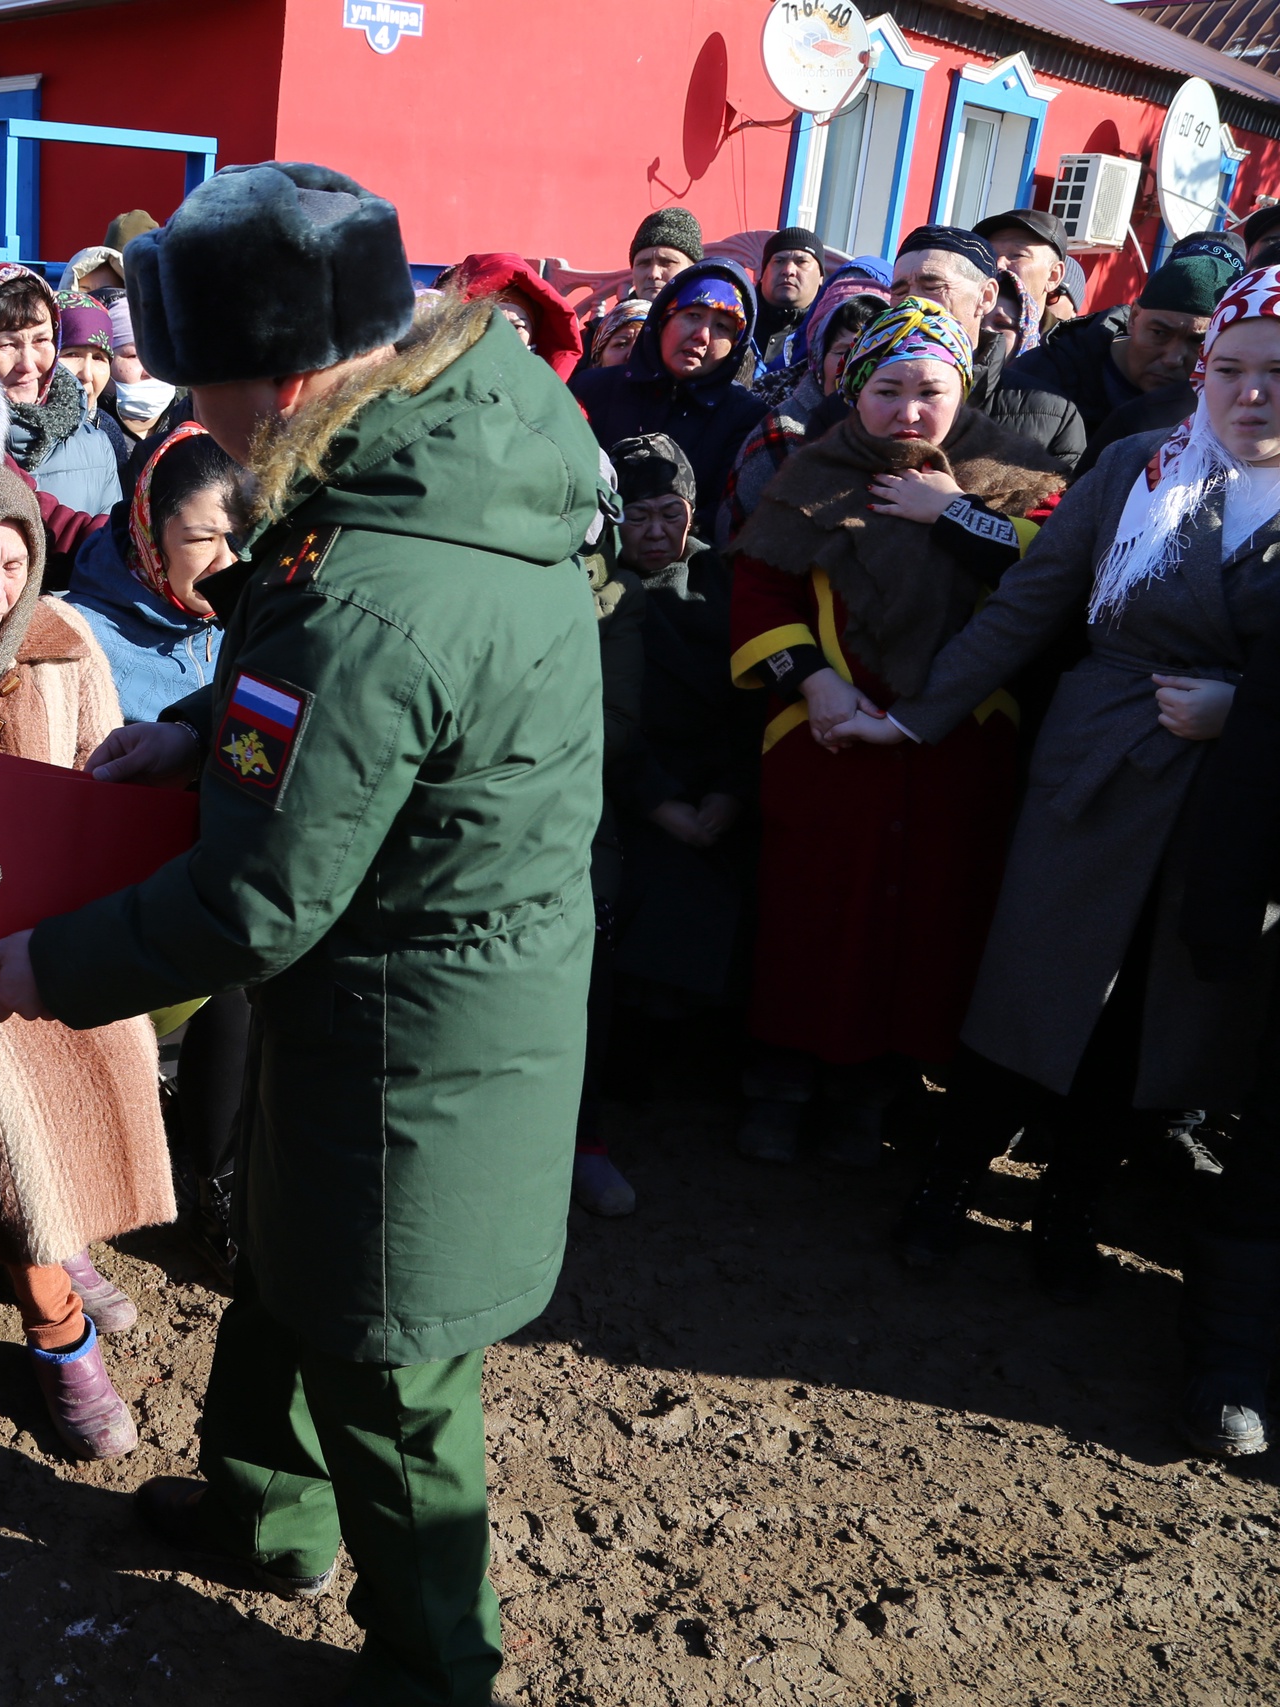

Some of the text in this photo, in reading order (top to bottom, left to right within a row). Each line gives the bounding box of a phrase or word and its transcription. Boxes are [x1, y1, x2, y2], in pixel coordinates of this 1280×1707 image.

[351, 4, 419, 29] ул.Мира
[375, 25, 390, 48] 4
[1194, 121, 1212, 149] 40
